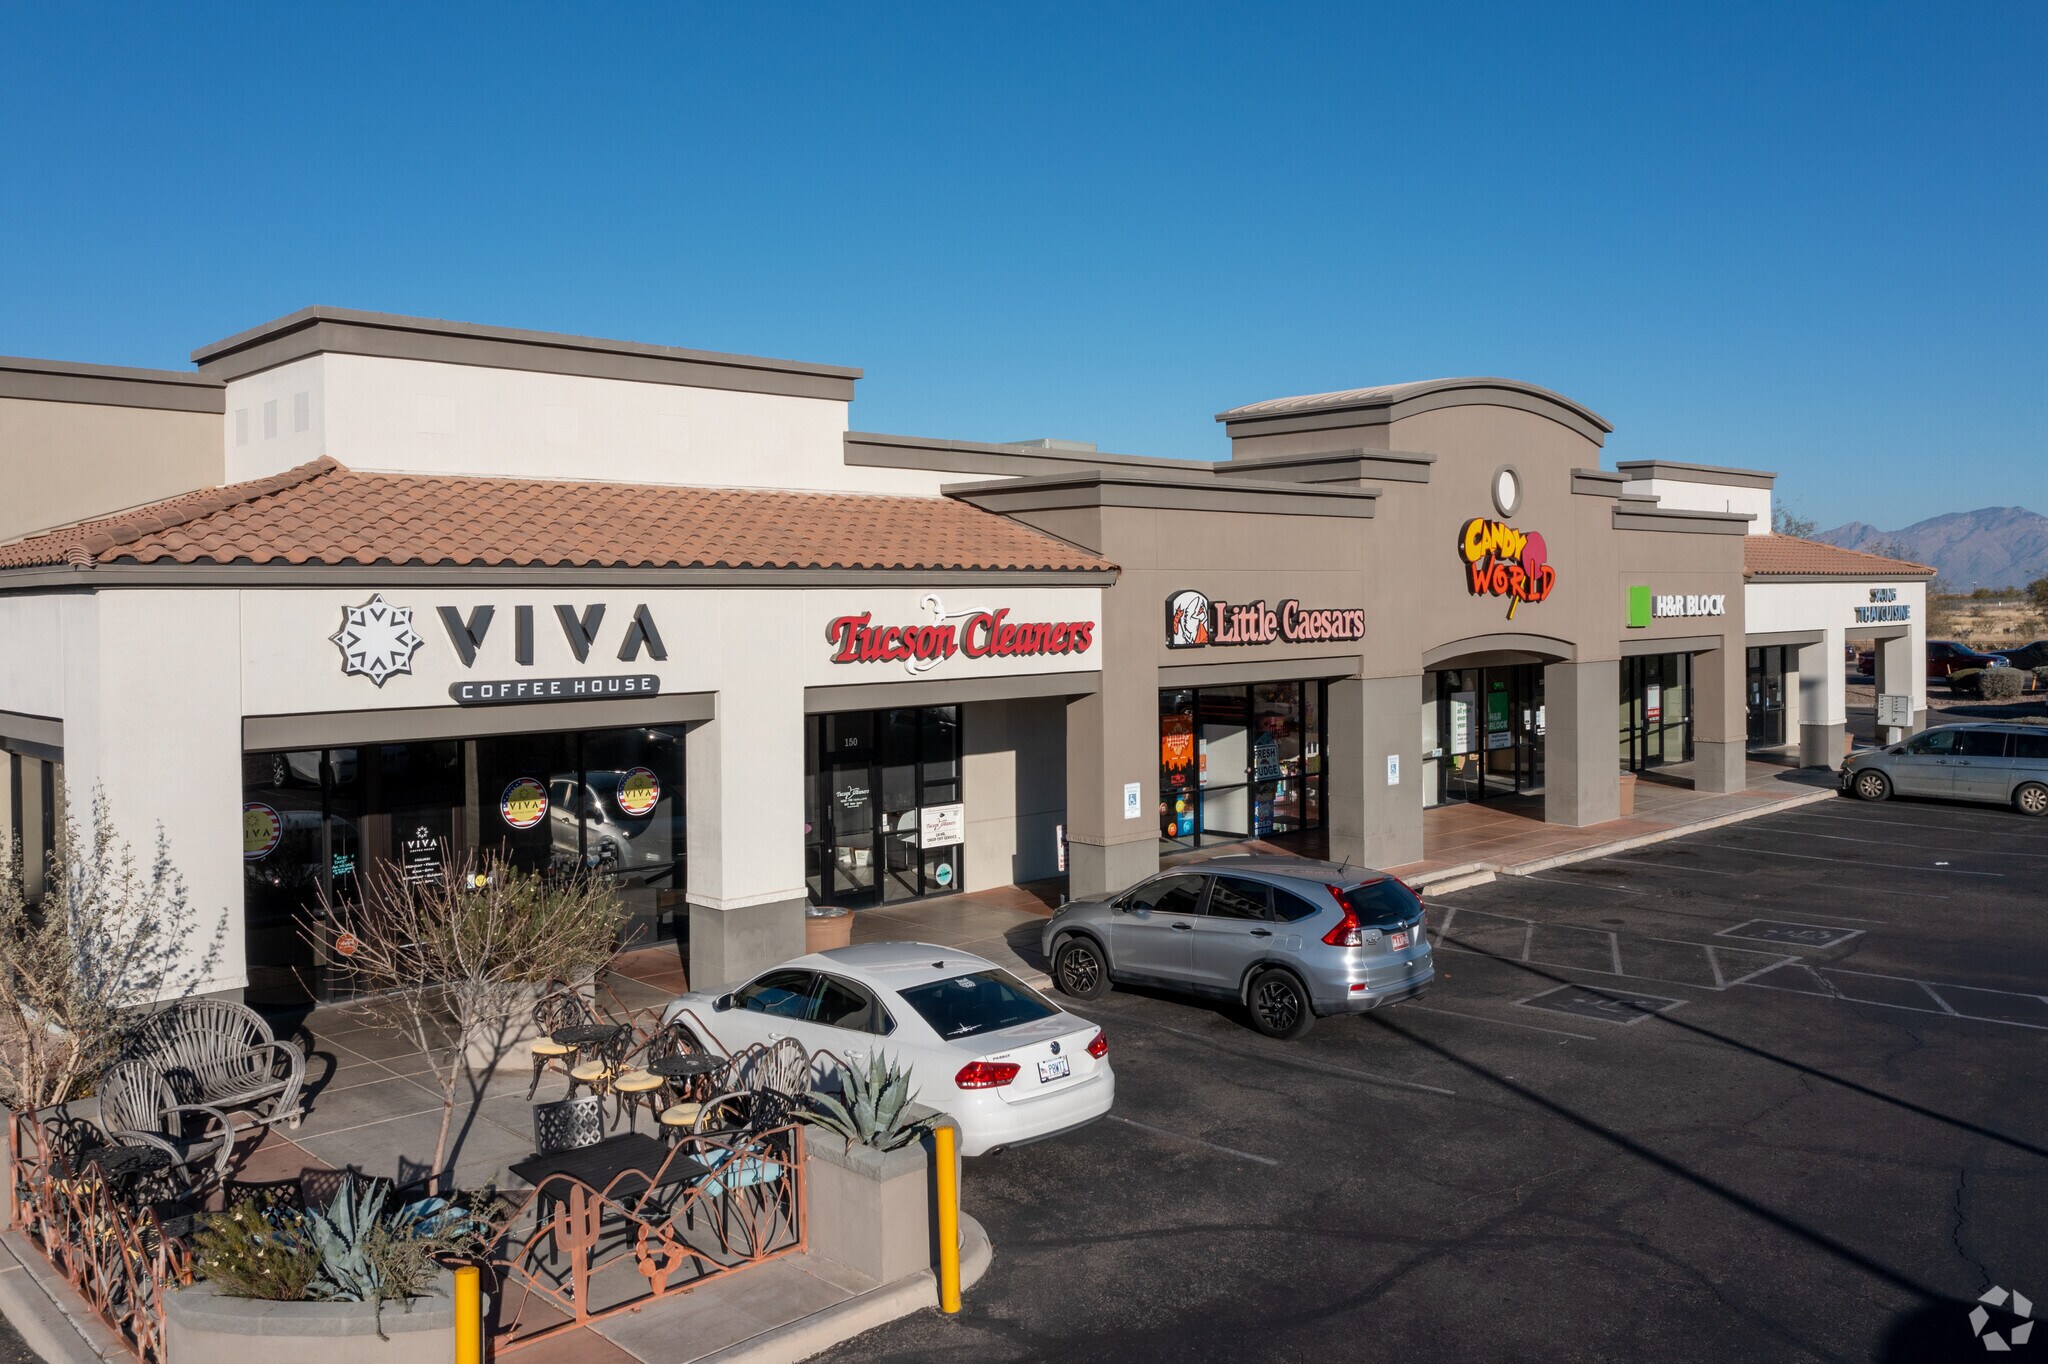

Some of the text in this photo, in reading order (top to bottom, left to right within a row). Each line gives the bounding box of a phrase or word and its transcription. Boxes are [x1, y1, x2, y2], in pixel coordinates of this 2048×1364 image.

[1459, 517, 1528, 563] CANDY
[1468, 554, 1555, 602] WORLD
[1654, 594, 1726, 617] H&R BLOCK
[1213, 599, 1365, 643] Little Caesars
[1855, 605, 1911, 623] THAI CUISINE
[436, 603, 668, 668] VIVA
[825, 608, 1095, 664] Tucson Cleaners
[462, 677, 653, 699] COFFEE HOUSE
[1489, 720, 1508, 730] BLOCK
[844, 738, 858, 747] 150
[1254, 748, 1276, 759] FRESH
[1254, 764, 1278, 776] FUDGE
[625, 789, 651, 798] VIVA
[510, 801, 539, 810] VIVA
[245, 828, 271, 839] IVA
[407, 839, 437, 849] VIVA
